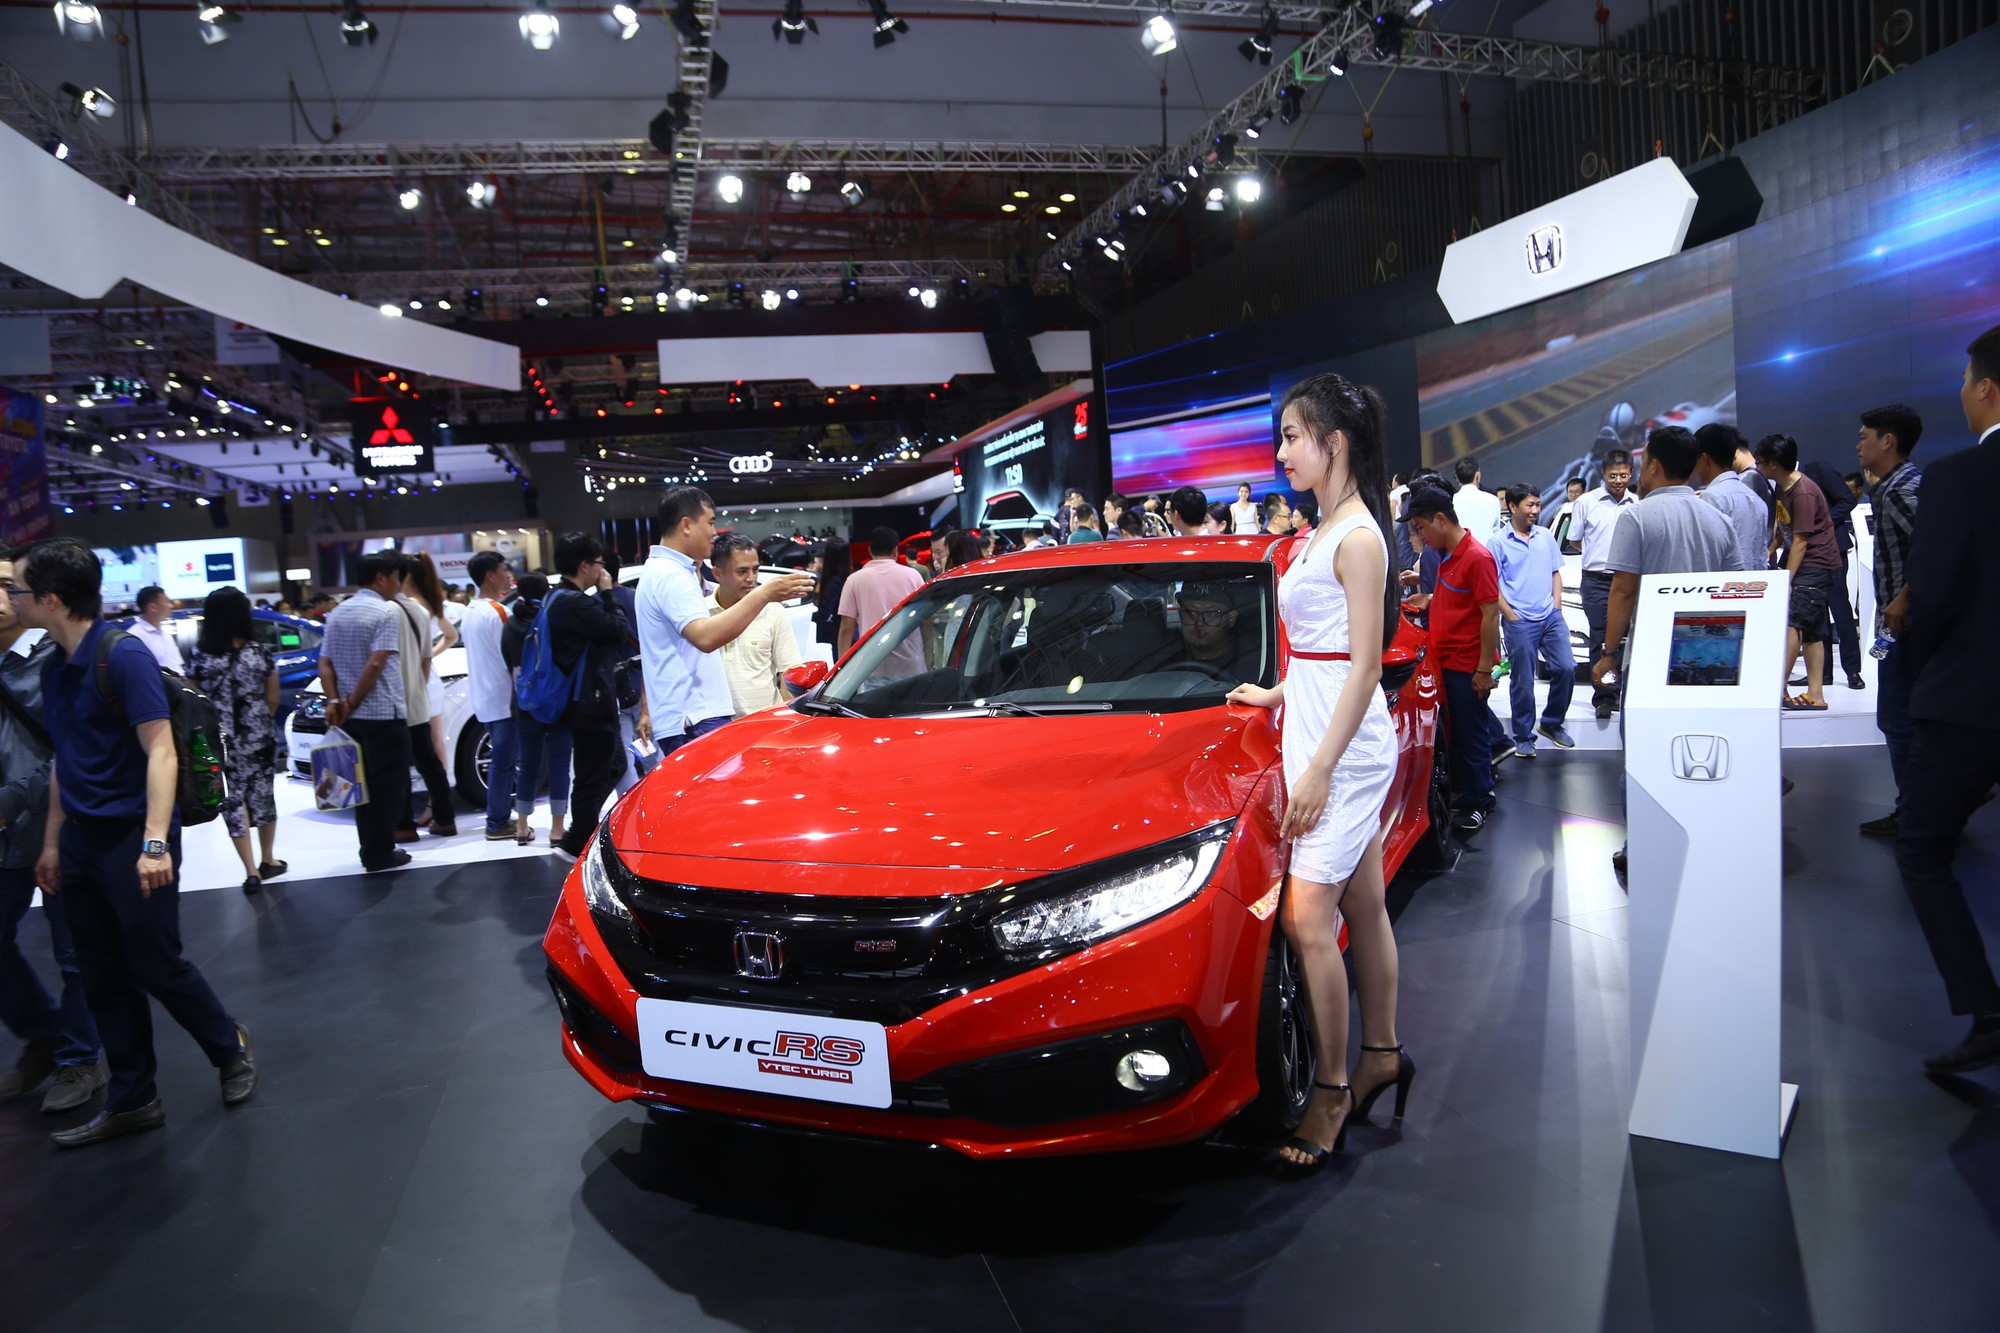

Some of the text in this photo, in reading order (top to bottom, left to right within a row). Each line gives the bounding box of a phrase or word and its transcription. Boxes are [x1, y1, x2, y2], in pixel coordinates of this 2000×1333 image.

[440, 560, 467, 568] HON
[1658, 581, 1768, 594] CIVIC RS
[854, 940, 897, 952] RS
[665, 1029, 865, 1067] CIVIC RS
